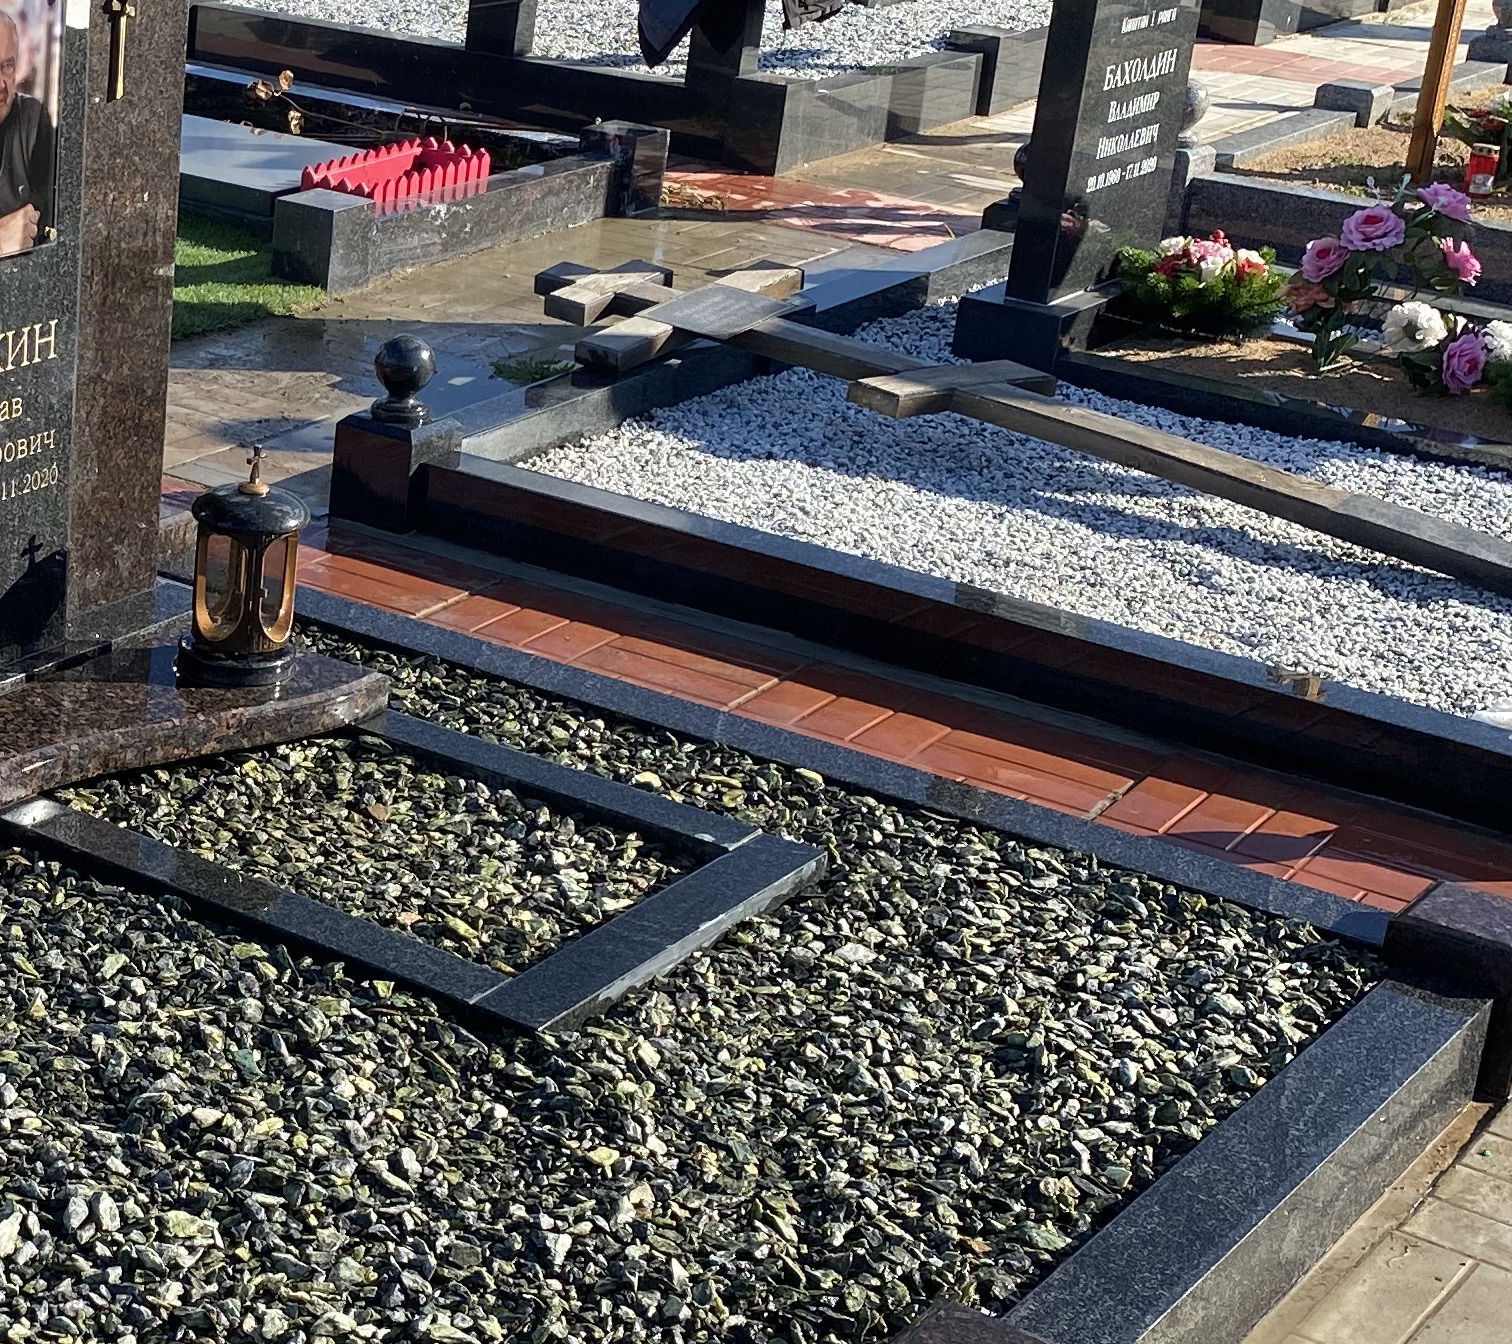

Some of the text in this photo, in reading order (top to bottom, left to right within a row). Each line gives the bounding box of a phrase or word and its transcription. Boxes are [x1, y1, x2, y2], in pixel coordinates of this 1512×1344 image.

[1103, 48, 1178, 92] БАХОЛДИН
[1107, 91, 1160, 124] ВЛАДИМИР
[1096, 123, 1160, 160] НИКОЛАЕВИЧ
